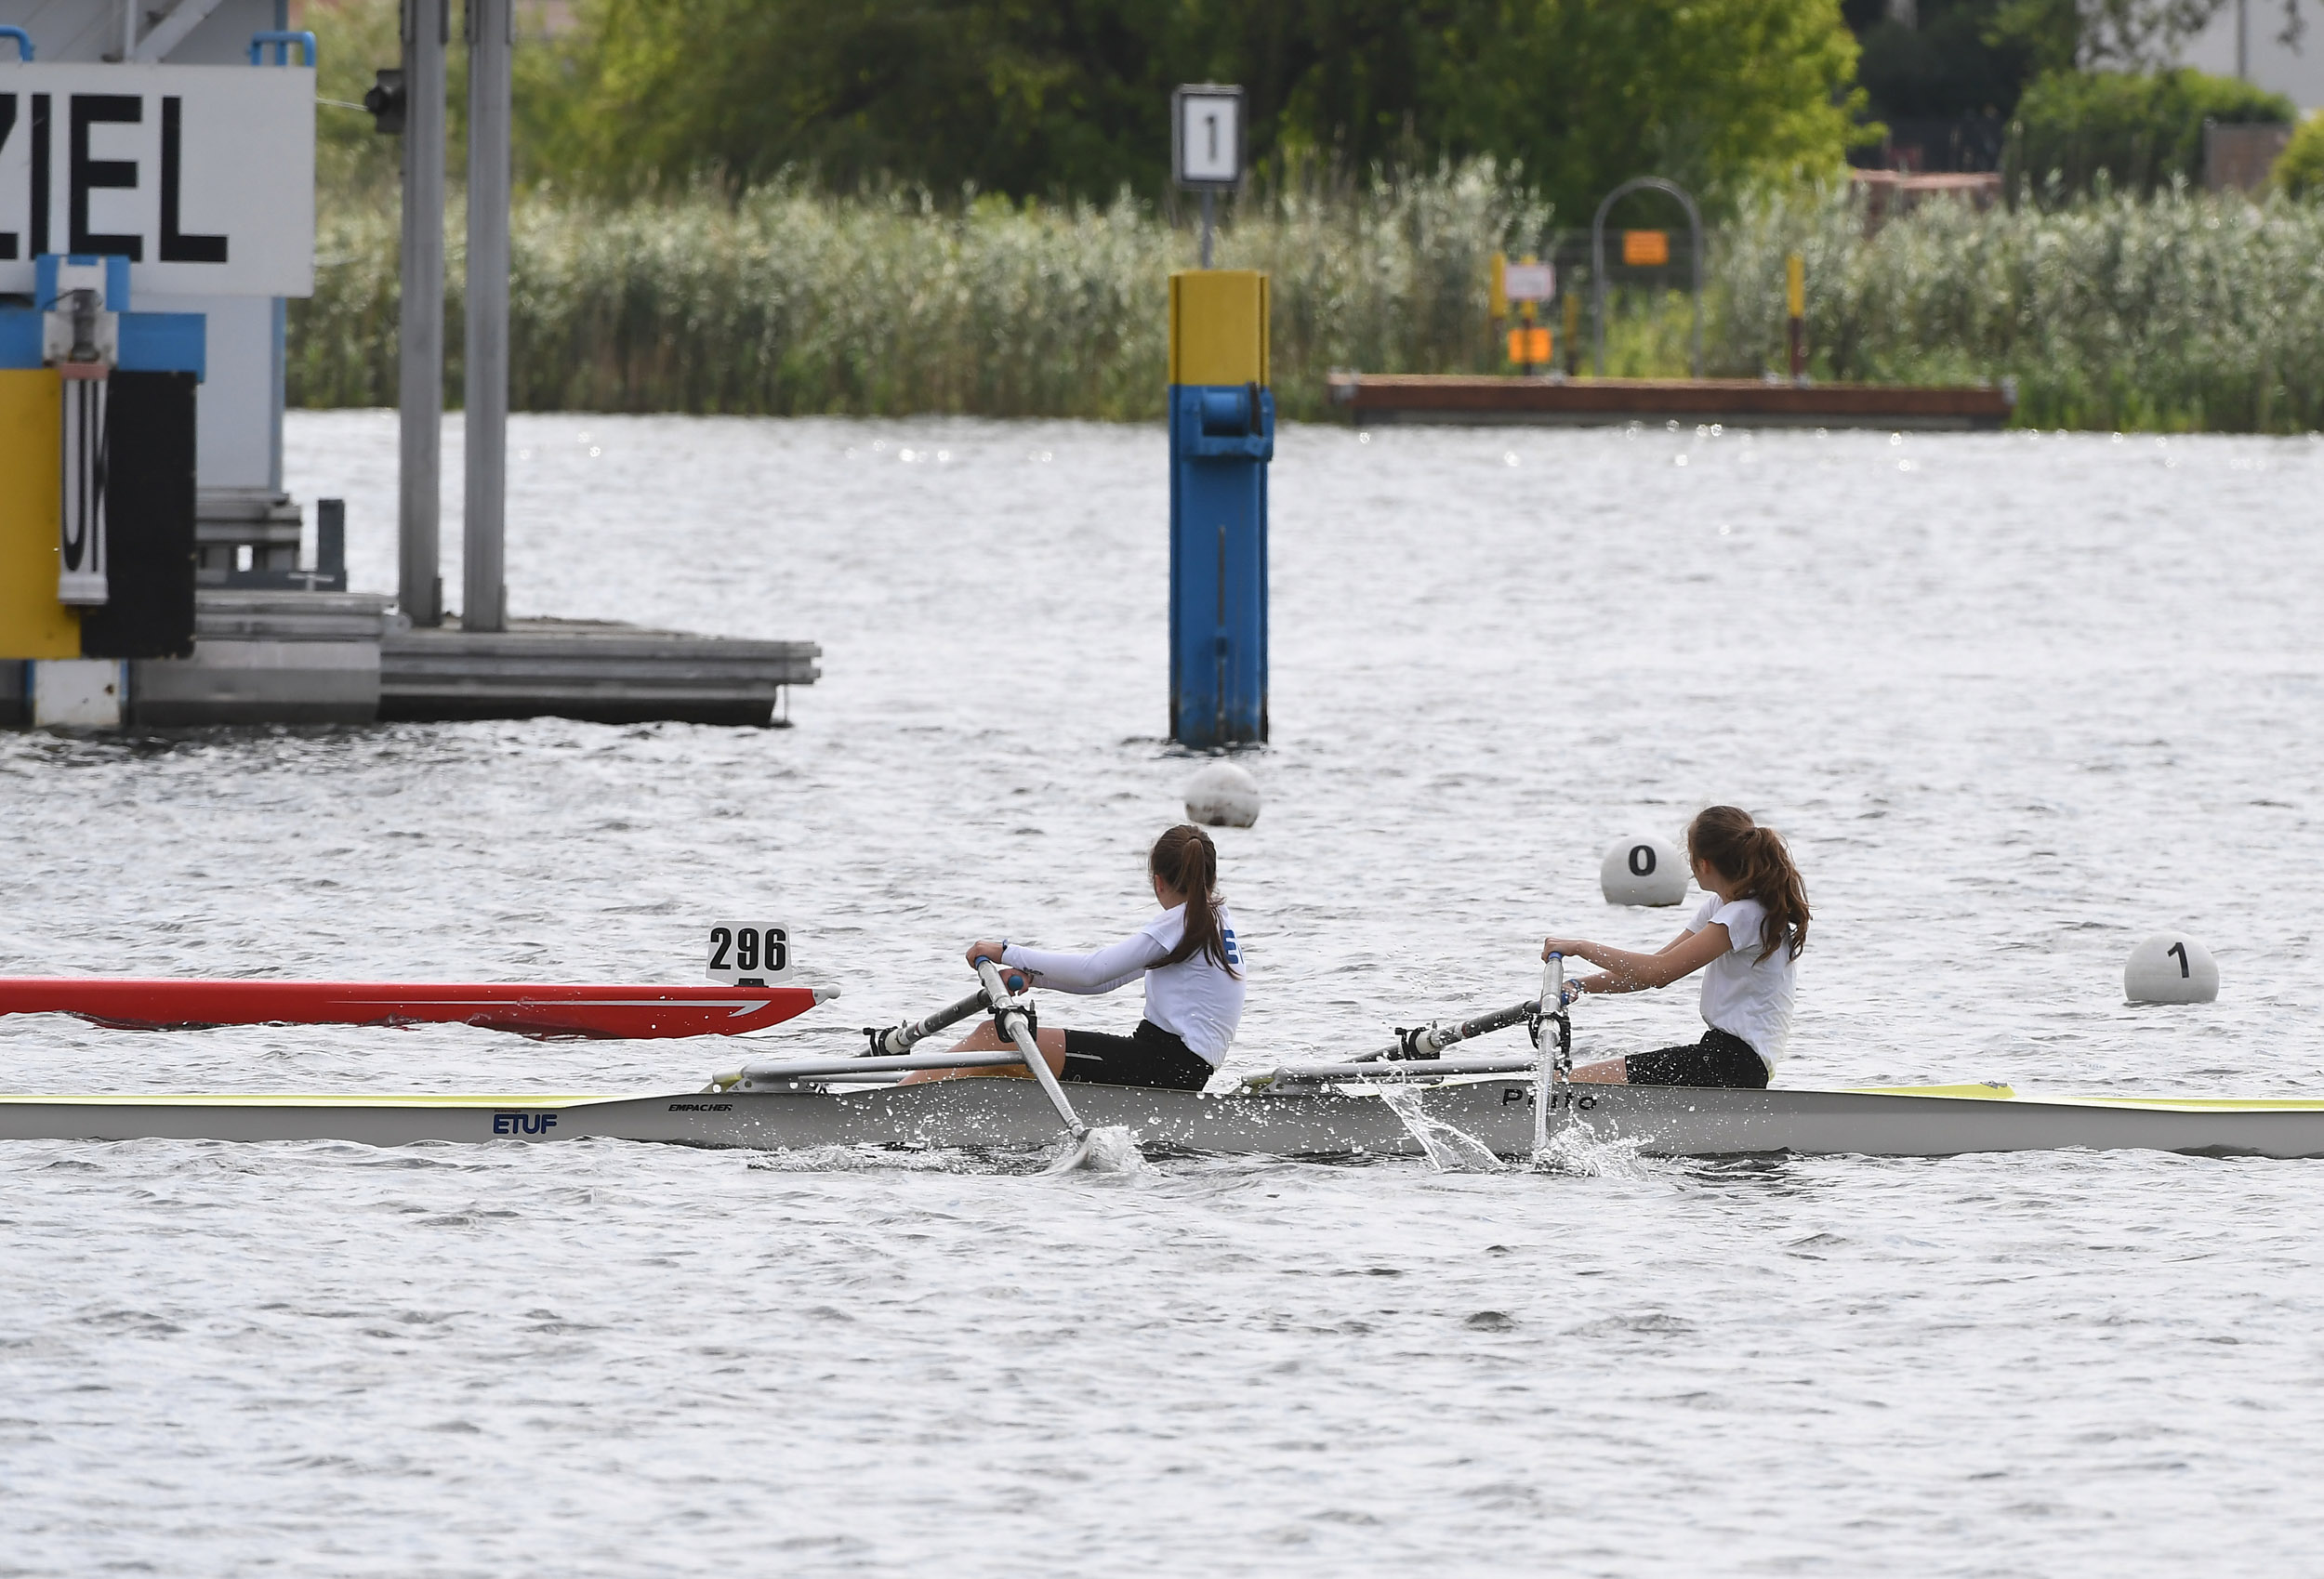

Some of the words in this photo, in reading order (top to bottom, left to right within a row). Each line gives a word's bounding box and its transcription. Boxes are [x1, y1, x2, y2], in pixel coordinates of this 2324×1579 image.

[1203, 114, 1218, 163] 1
[0, 94, 228, 263] IEL
[1629, 845, 1657, 876] 0
[709, 927, 786, 971] 296
[1222, 929, 1244, 964] E
[2167, 941, 2189, 979] 1
[493, 1113, 558, 1135] ETUF
[667, 1103, 733, 1112] EMPACHER
